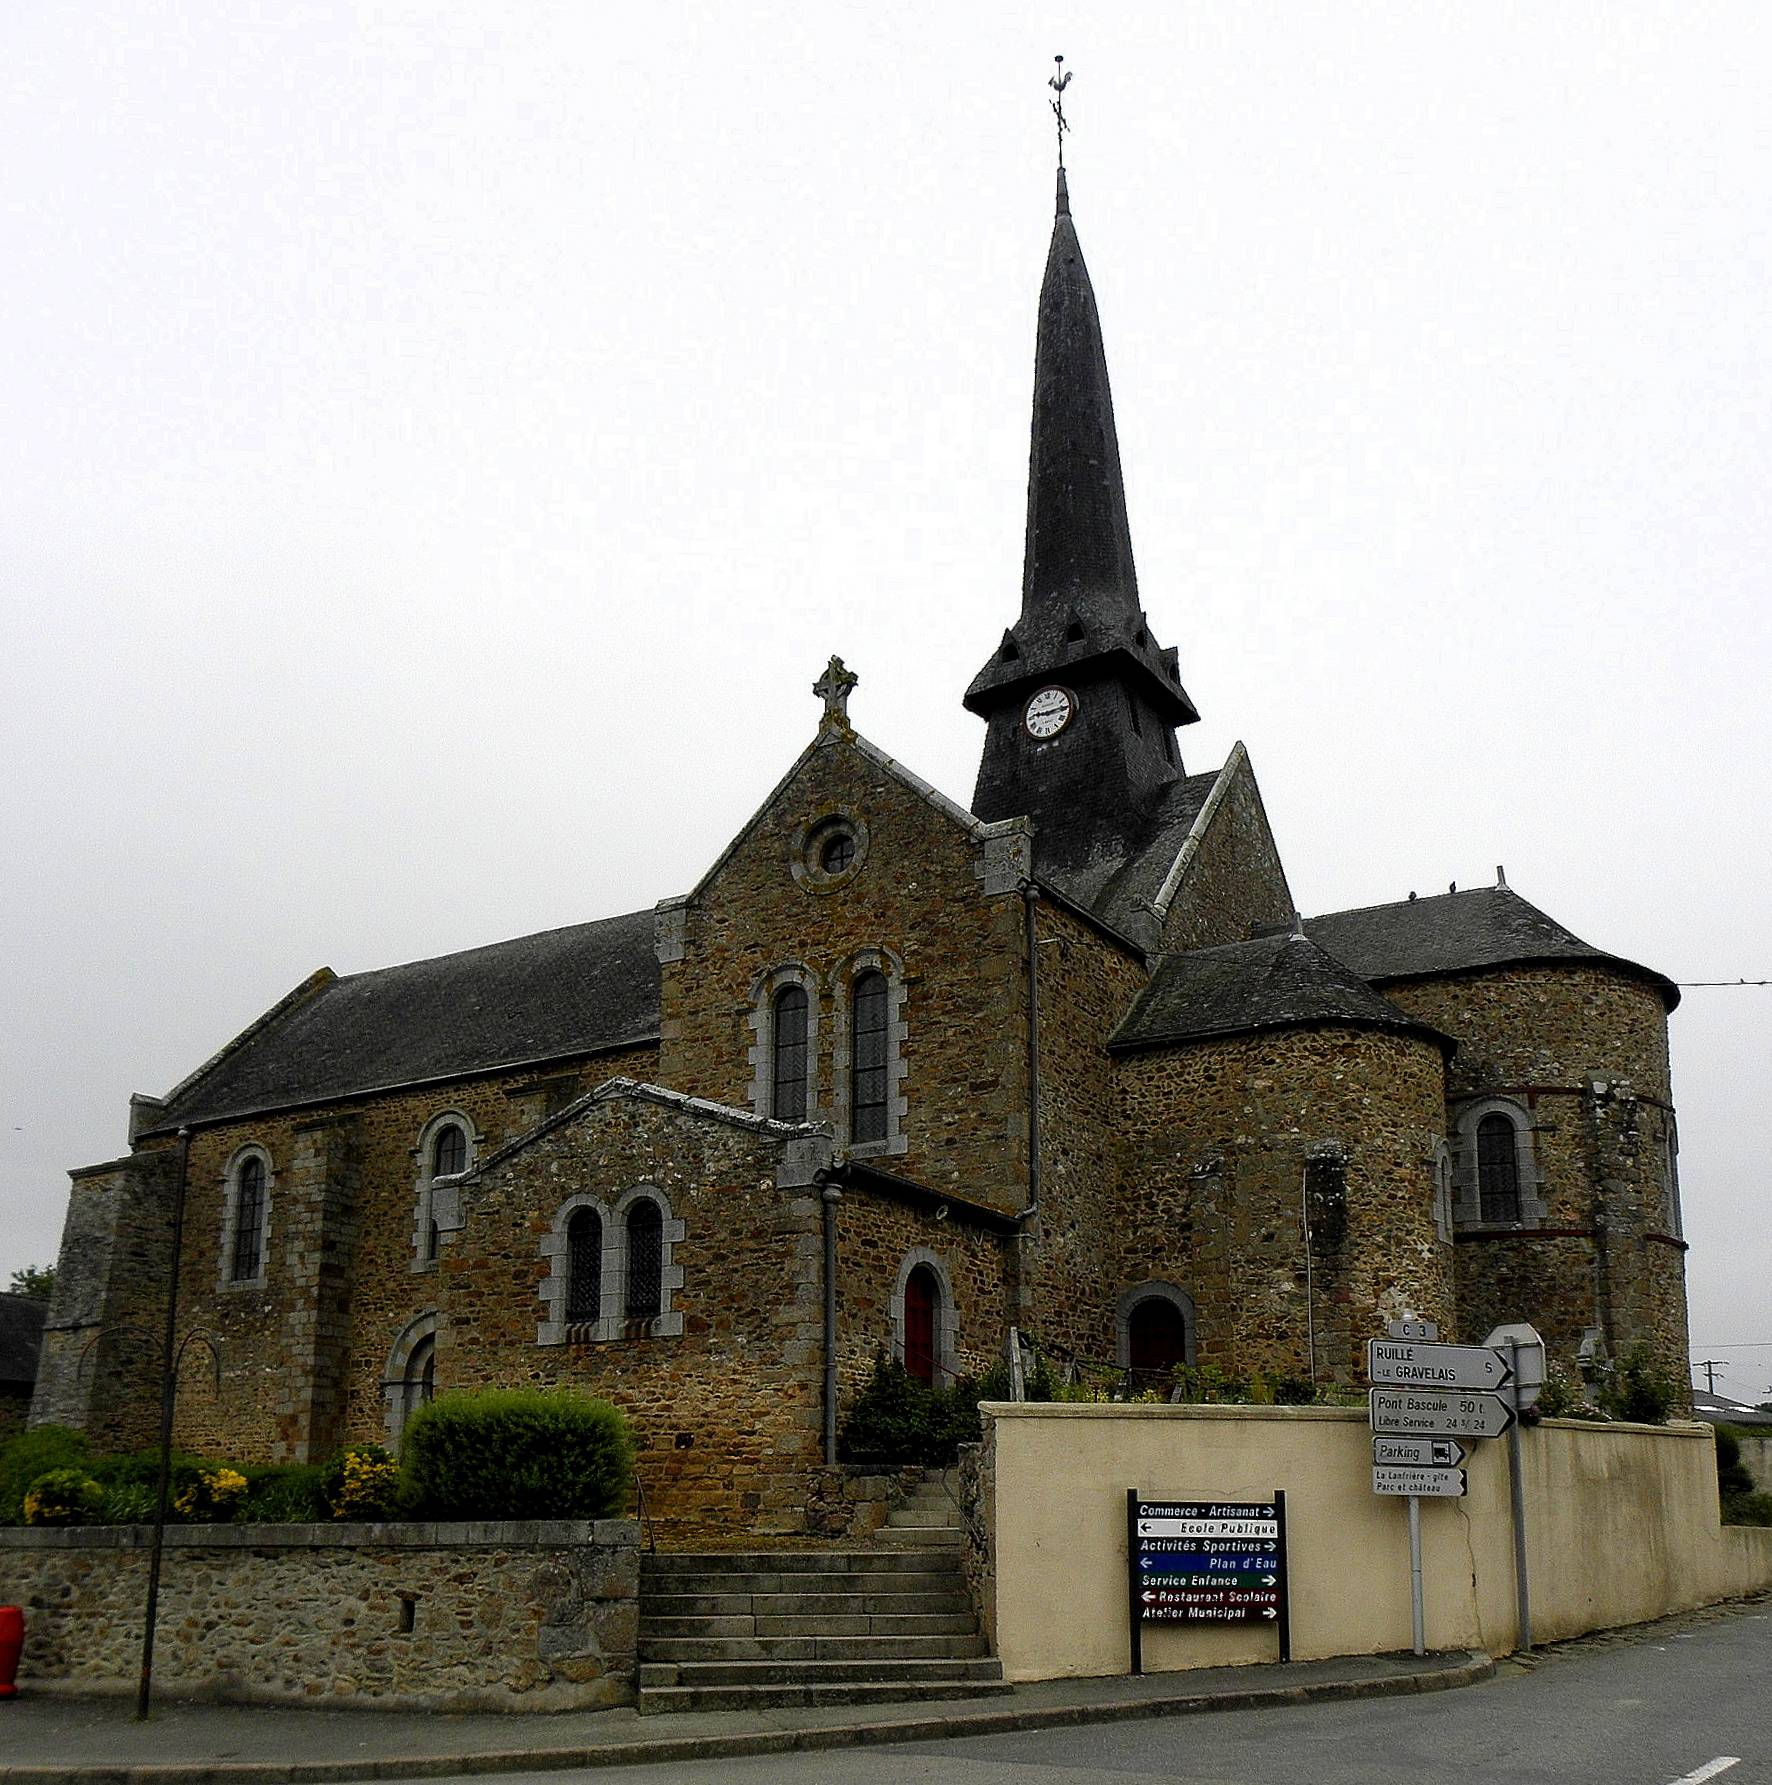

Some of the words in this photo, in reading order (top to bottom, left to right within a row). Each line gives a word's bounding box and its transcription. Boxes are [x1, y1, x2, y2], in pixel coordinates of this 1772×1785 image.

[1402, 1324, 1410, 1336] C
[1419, 1325, 1426, 1337] 3
[1376, 1346, 1413, 1361] RUILLÉ
[1396, 1365, 1456, 1380] GRAVELAIS
[1378, 1397, 1403, 1410] Pont
[1407, 1398, 1447, 1411] Bascule
[1459, 1401, 1475, 1413] 50
[1378, 1416, 1399, 1426] Libre
[1403, 1417, 1435, 1428] Service
[1446, 1419, 1457, 1428] 24
[1473, 1420, 1485, 1430] 24
[1380, 1445, 1420, 1461] Parking
[1140, 1505, 1198, 1516] Commerce
[1209, 1506, 1259, 1517] Artisanat
[1220, 1524, 1275, 1535] Publique
[1140, 1540, 1196, 1551] Activités
[1202, 1540, 1261, 1553] Sportives
[1209, 1558, 1236, 1568] Plan
[1142, 1575, 1186, 1585] Service
[1192, 1576, 1238, 1585] Enfance
[1229, 1592, 1276, 1602] Scolaire
[1188, 1608, 1245, 1620] Municipal
